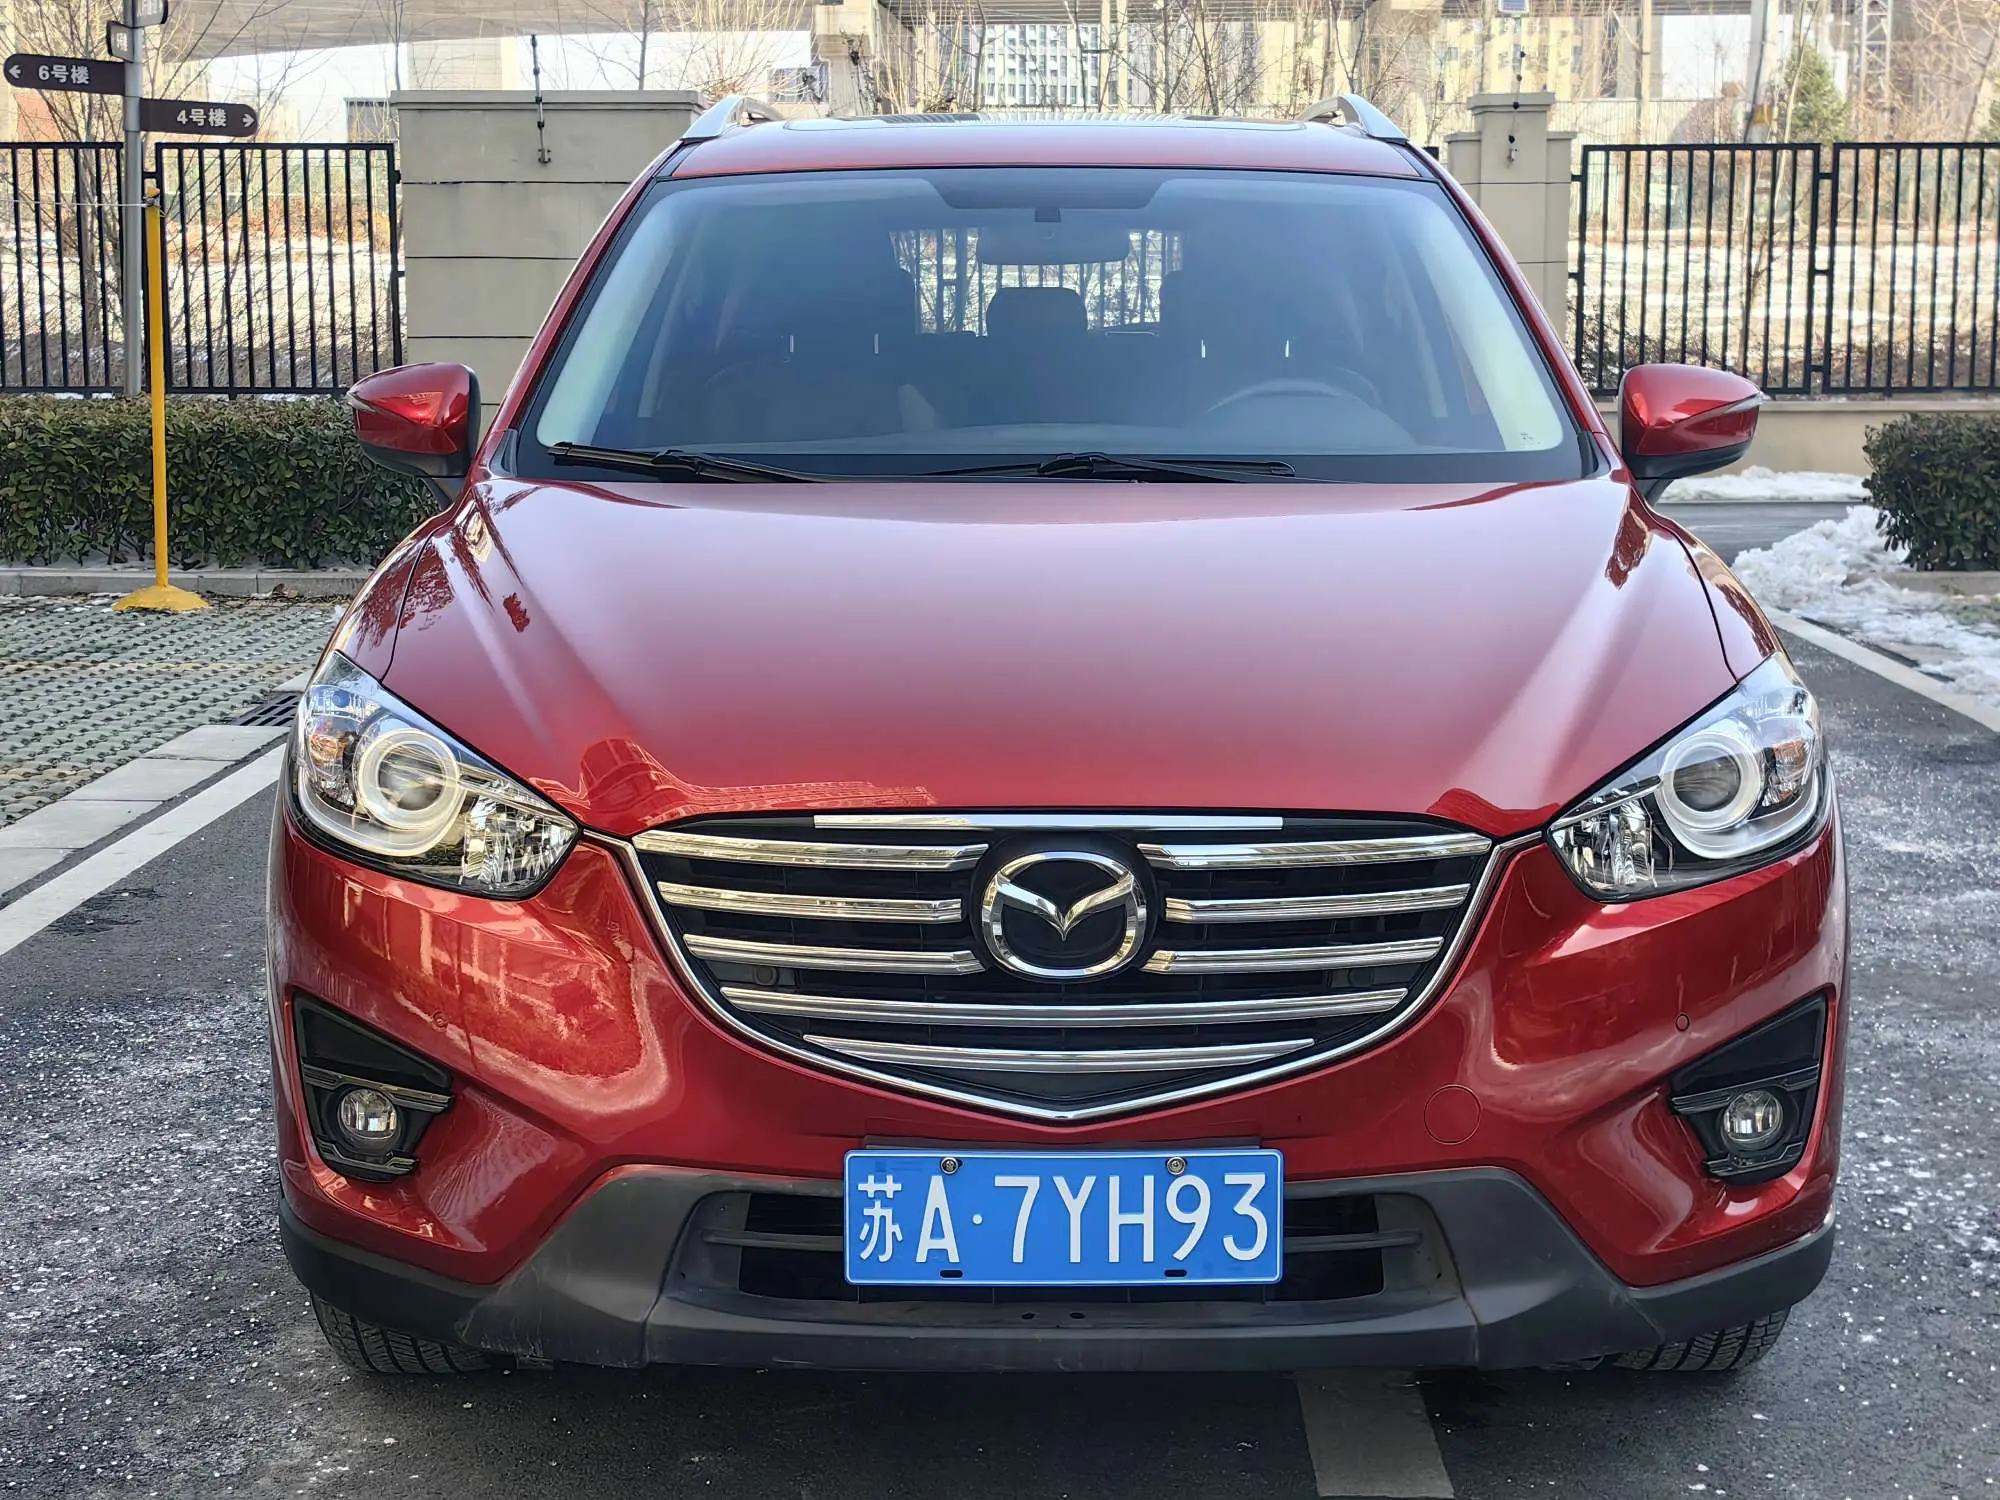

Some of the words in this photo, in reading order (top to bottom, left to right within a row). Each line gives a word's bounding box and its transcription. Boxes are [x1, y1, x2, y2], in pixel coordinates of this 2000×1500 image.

[38, 65, 90, 84] 6号楼
[176, 108, 227, 127] 4号楼
[857, 1175, 1268, 1263] 苏A·7YH93
